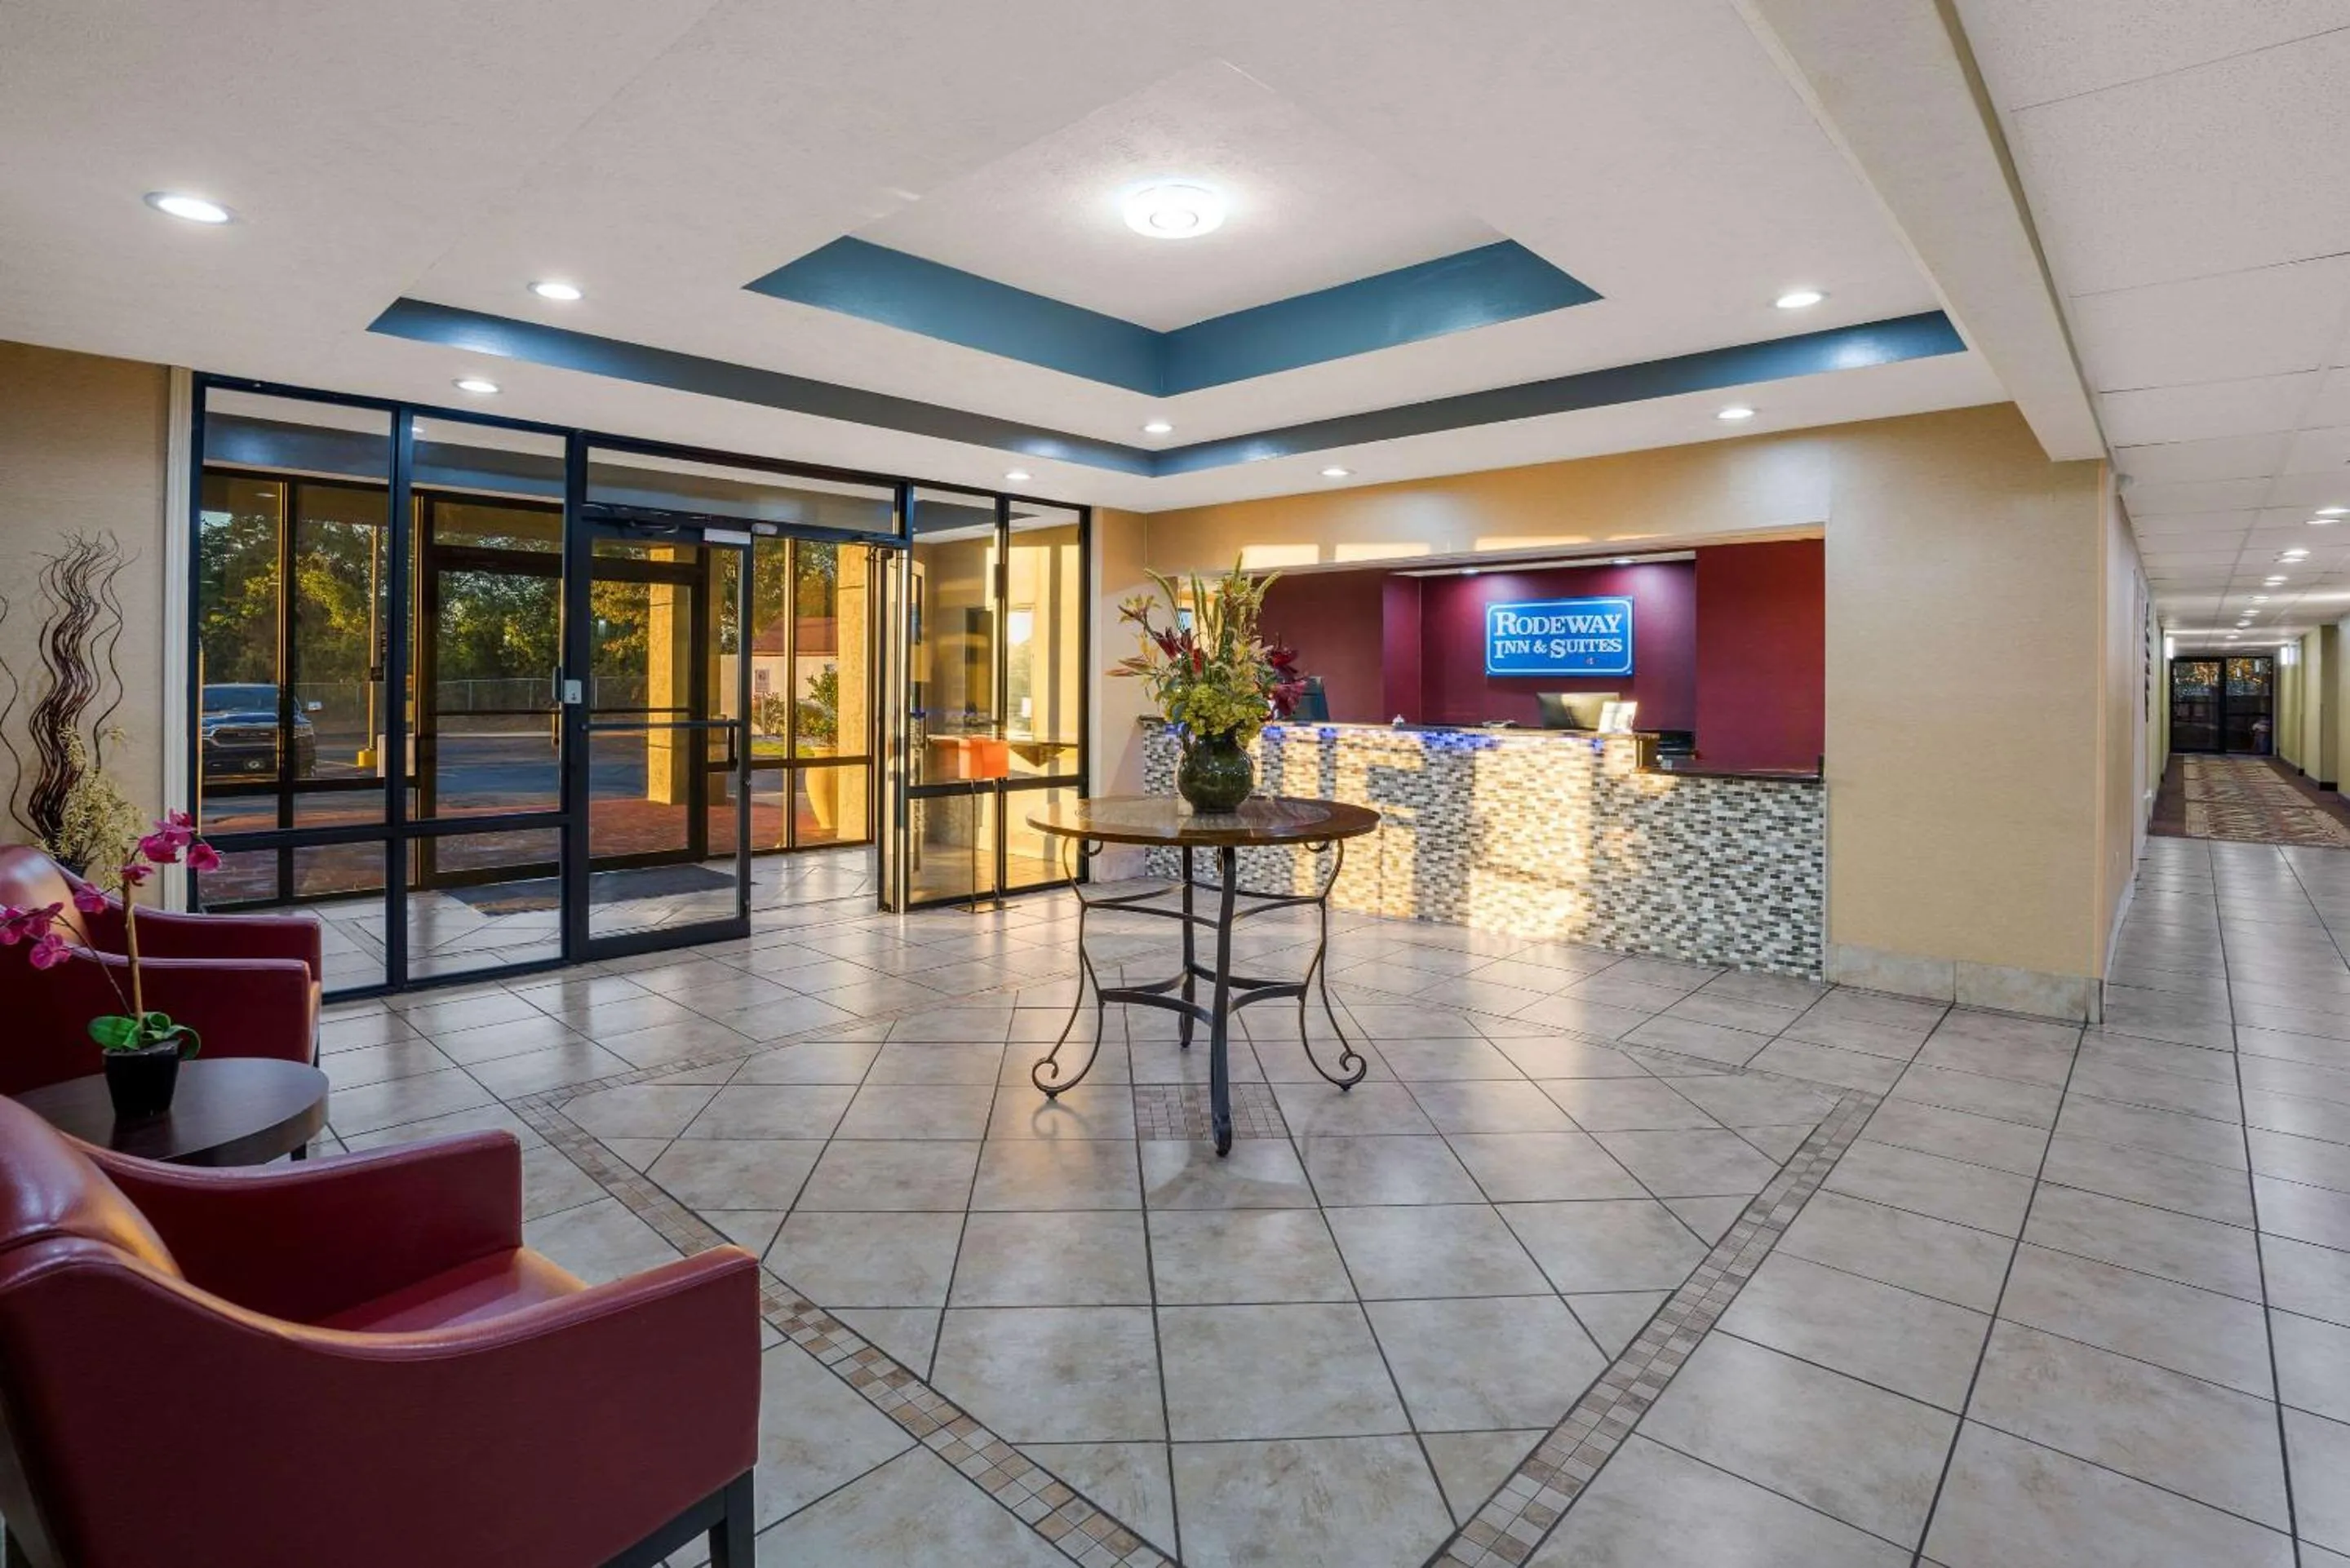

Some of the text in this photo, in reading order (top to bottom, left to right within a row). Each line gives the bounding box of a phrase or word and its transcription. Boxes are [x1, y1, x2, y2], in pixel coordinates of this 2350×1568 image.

[1494, 612, 1622, 636] RODEWAY
[1494, 639, 1622, 658] INN & SUITES
